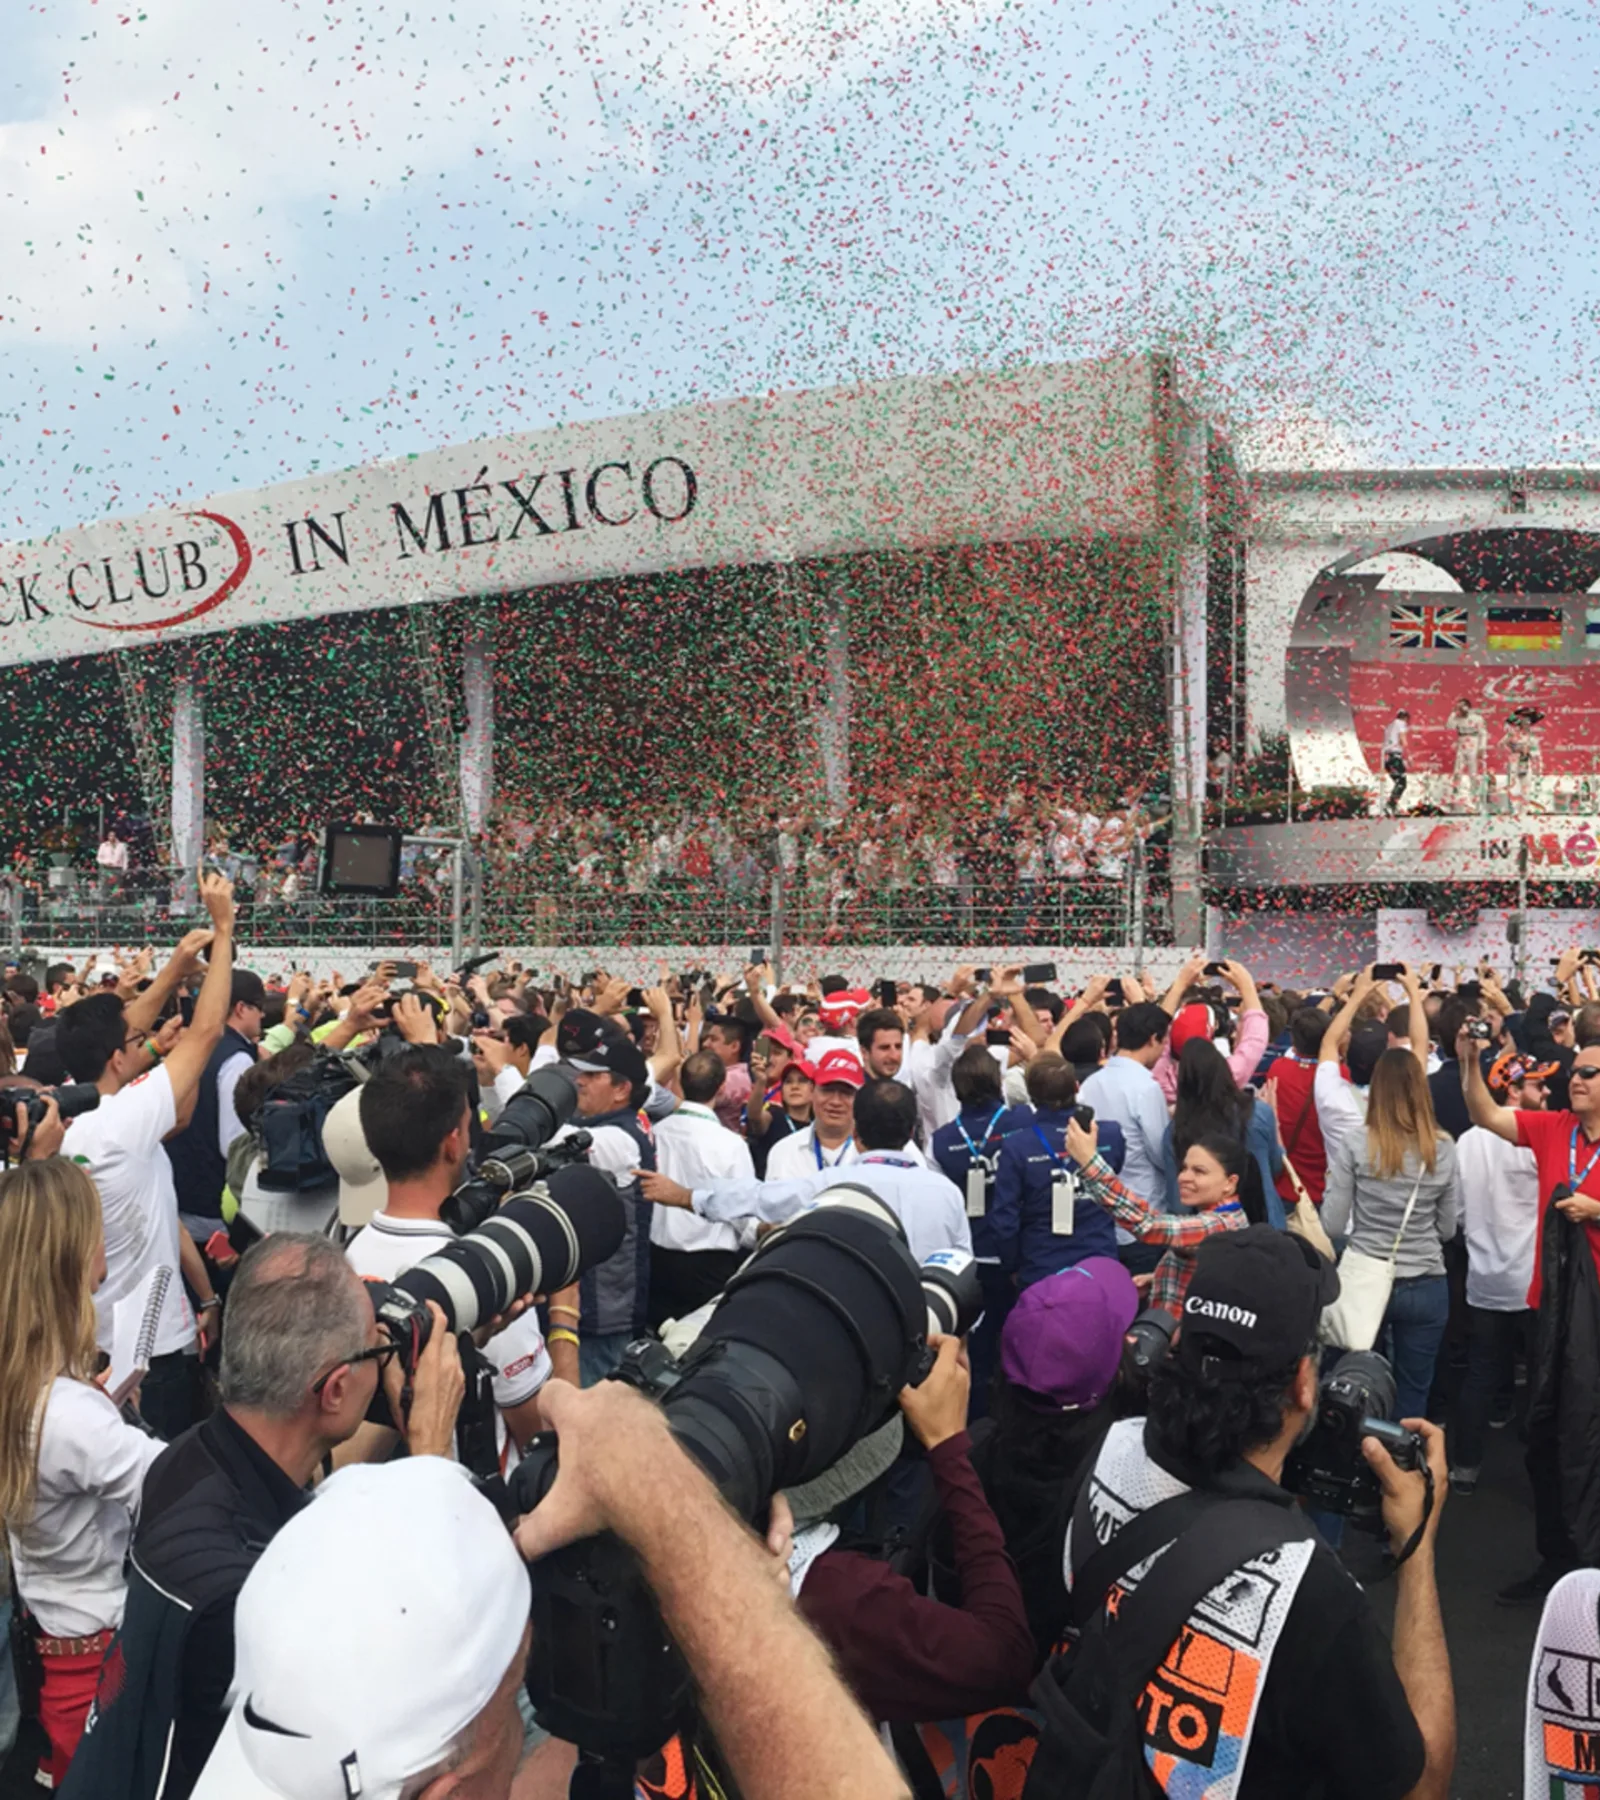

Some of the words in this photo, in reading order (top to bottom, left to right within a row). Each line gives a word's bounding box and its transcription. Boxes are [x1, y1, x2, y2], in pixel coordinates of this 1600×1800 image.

[281, 511, 350, 575] IN
[389, 465, 698, 560] MÉXICO
[1480, 839, 1510, 860] IN
[1185, 1295, 1258, 1330] Canon
